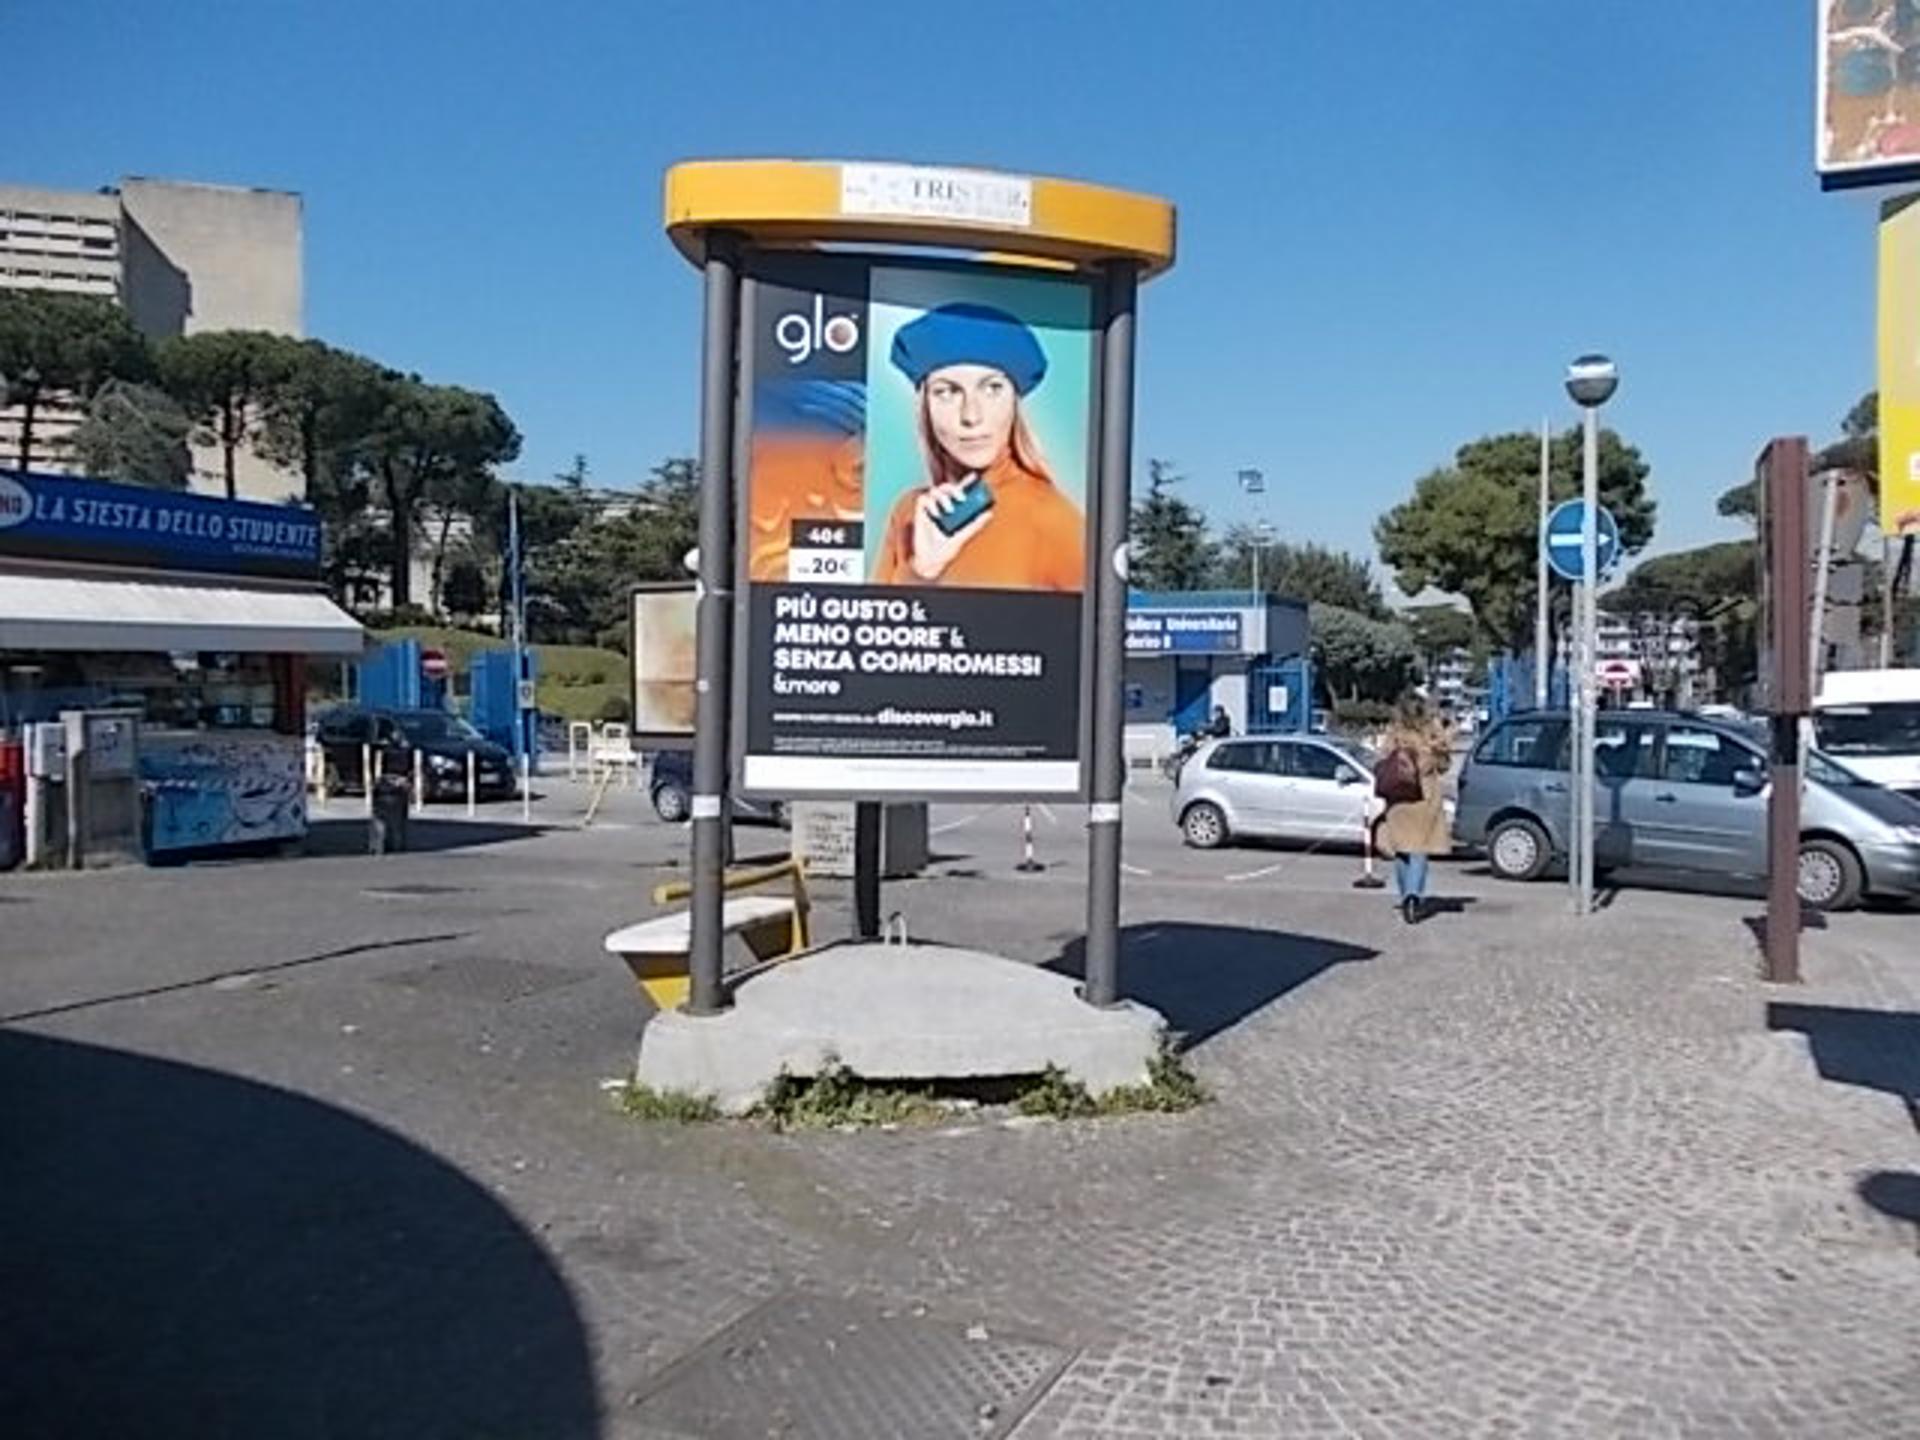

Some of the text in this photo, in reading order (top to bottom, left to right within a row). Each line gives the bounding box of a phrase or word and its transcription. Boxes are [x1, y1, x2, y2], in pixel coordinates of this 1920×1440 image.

[776, 293, 859, 363] glo
[35, 495, 318, 547] LA SIESTA DELLO STUDENTE
[808, 526, 846, 544] 40€
[812, 556, 857, 577] 20€
[776, 592, 928, 621] PIÙ GUSTO &
[774, 623, 851, 644] MENO
[1166, 615, 1238, 631] Universitaria
[773, 648, 1043, 676] SENZA COMPROMESSI
[773, 671, 841, 695] &more
[877, 707, 994, 730] discoverglo.it
